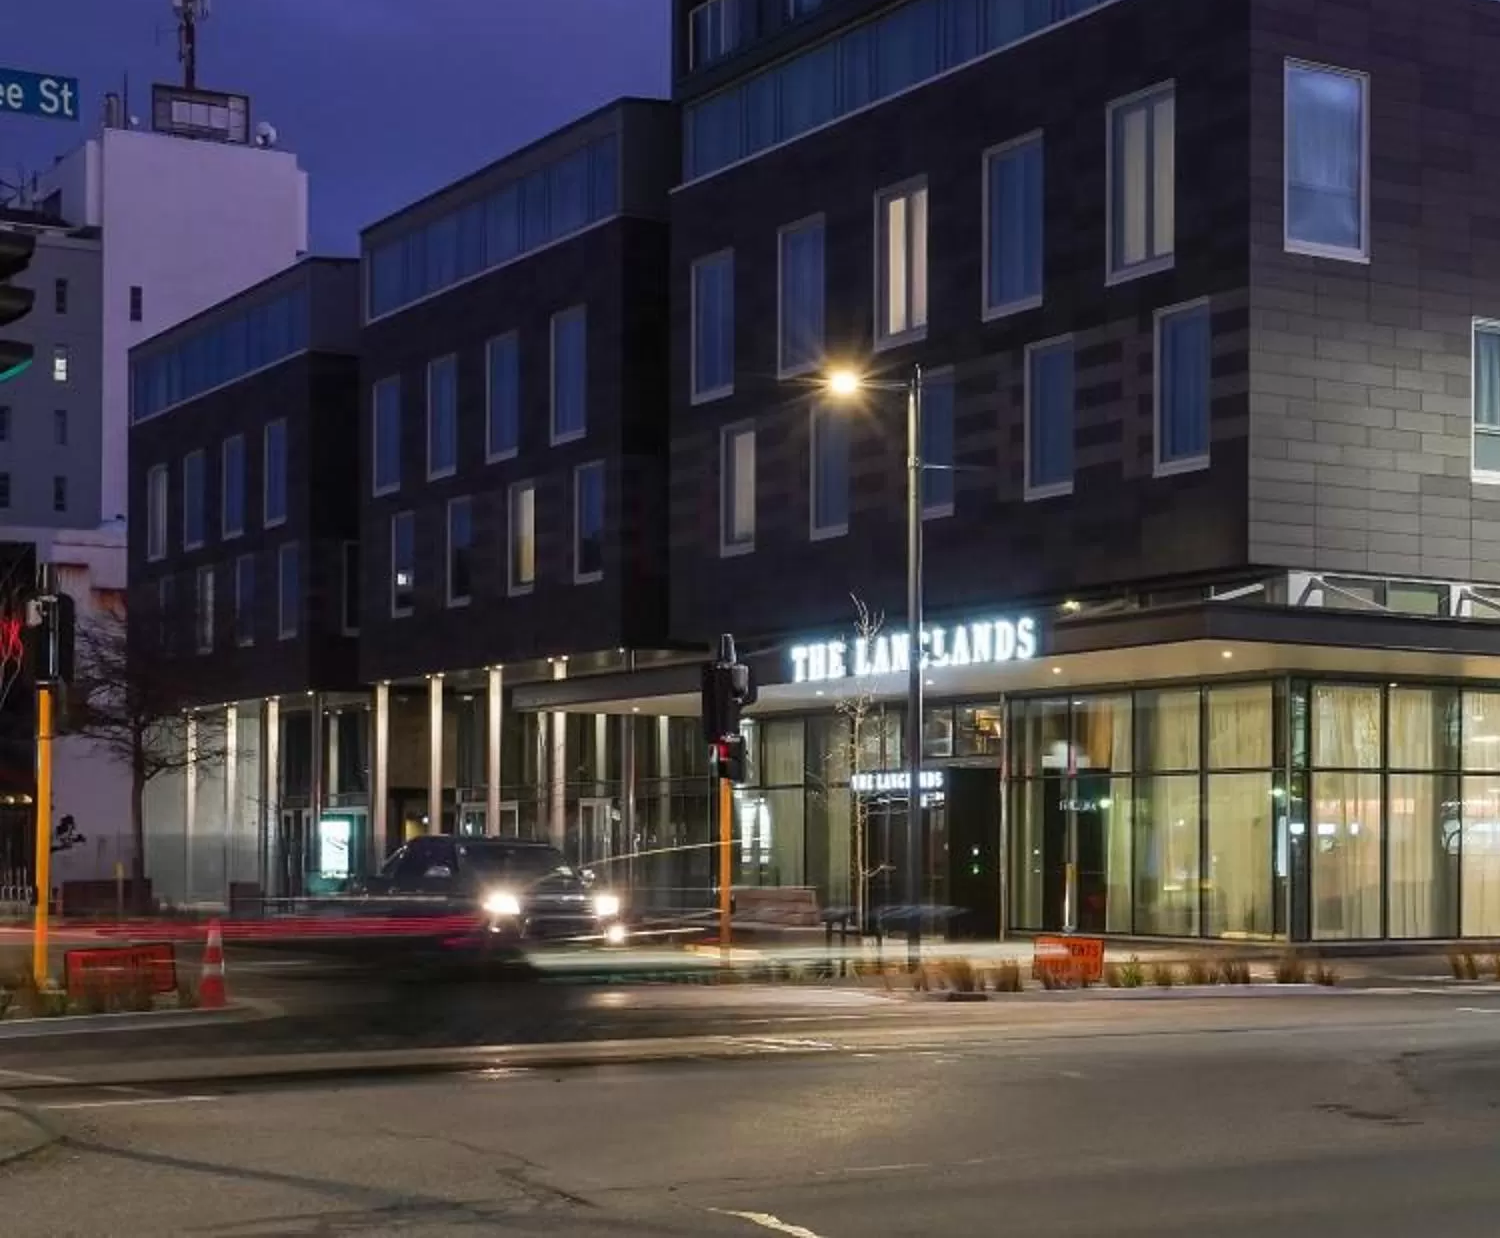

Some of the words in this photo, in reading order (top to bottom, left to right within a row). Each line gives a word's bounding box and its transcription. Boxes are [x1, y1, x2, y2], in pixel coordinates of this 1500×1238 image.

[0, 82, 24, 109] e
[40, 78, 74, 116] St
[791, 641, 847, 683] THE
[876, 771, 944, 790] LANGNDS
